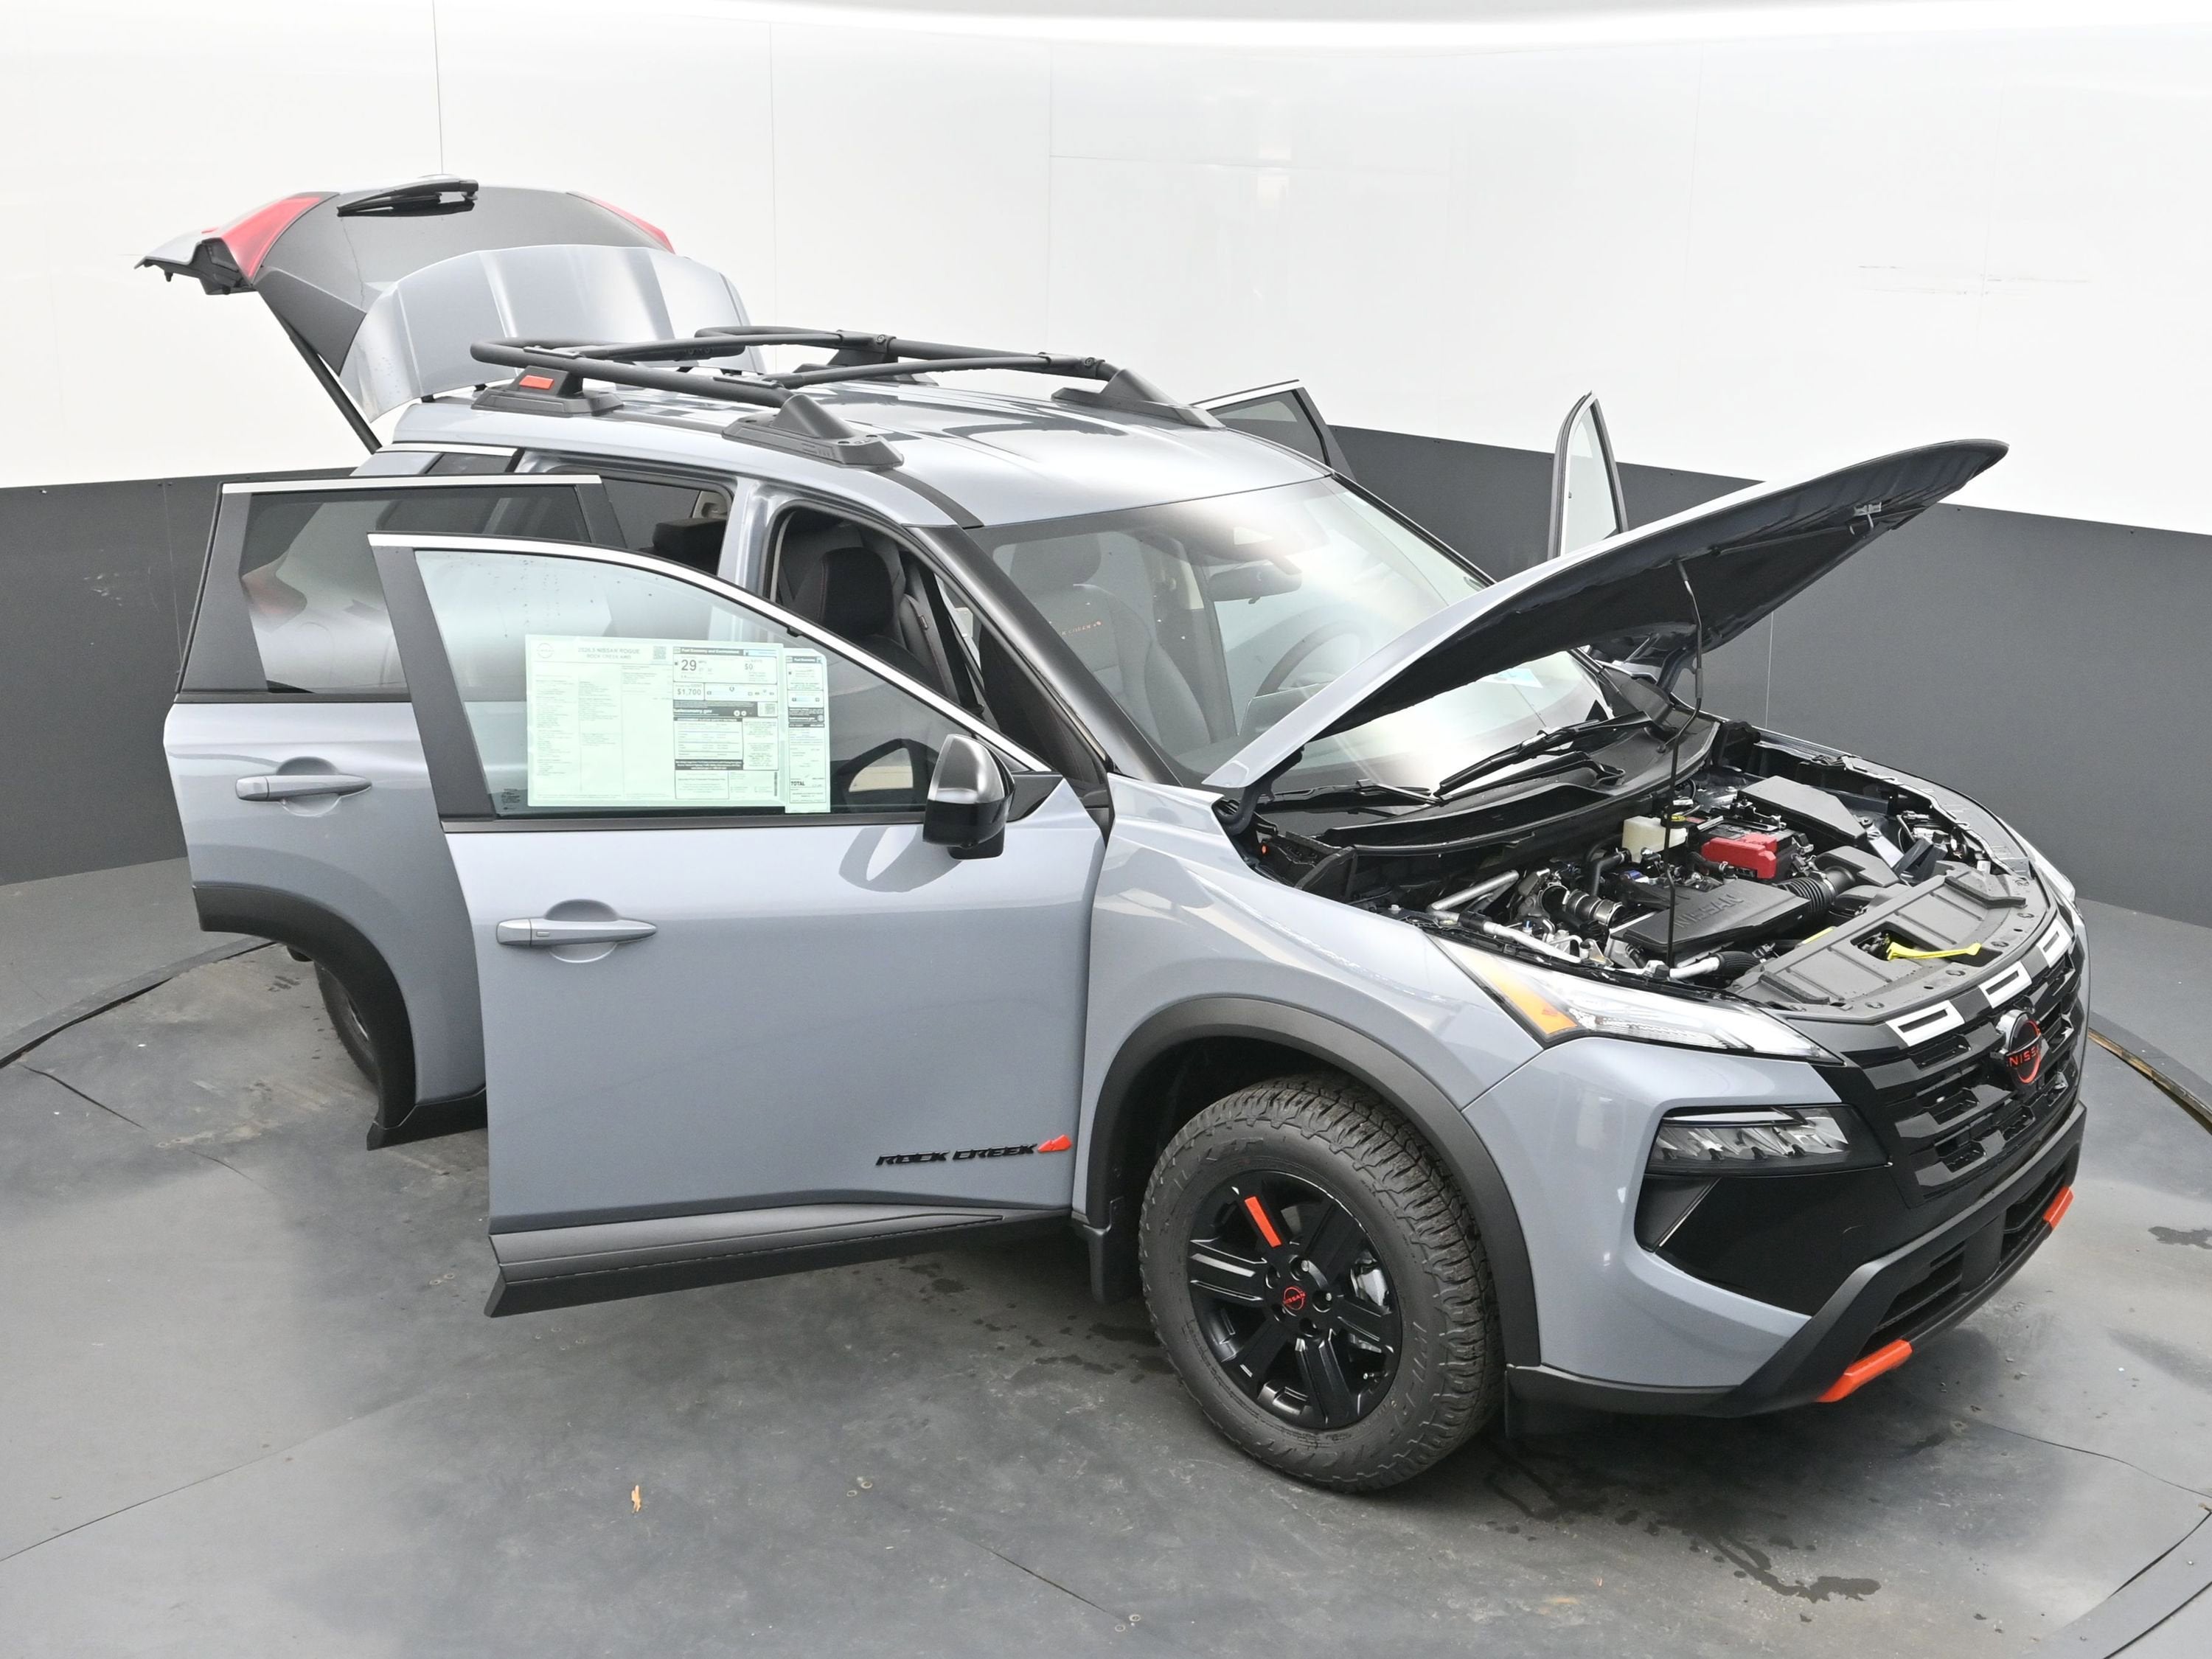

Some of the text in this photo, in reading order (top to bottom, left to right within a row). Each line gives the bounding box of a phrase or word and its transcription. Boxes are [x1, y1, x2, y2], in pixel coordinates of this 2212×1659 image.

[681, 659, 697, 671] 29
[677, 688, 702, 696] $1,700
[875, 1144, 1038, 1166] ROCK CREEK
